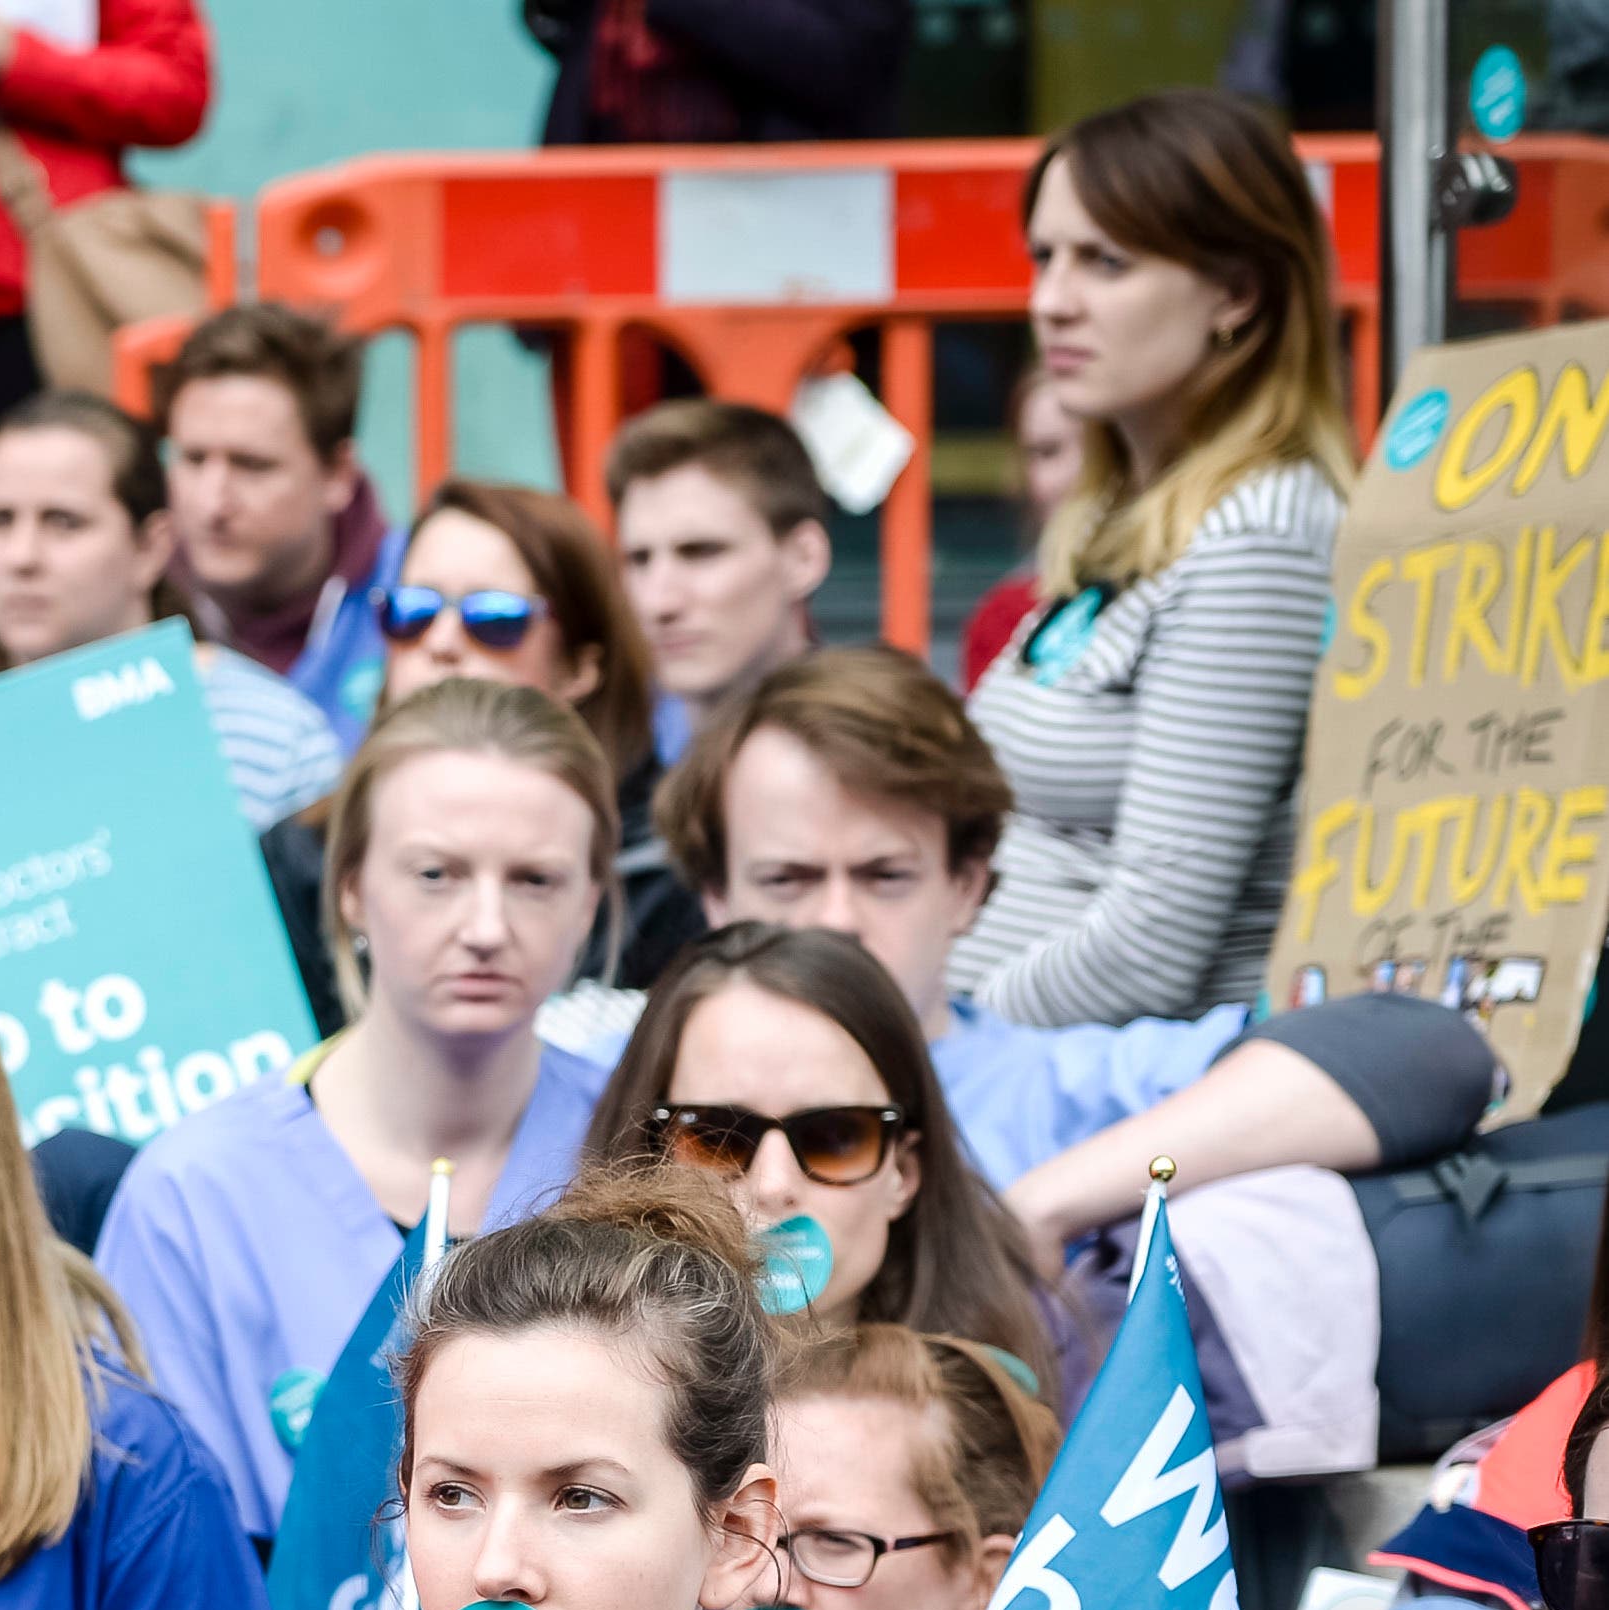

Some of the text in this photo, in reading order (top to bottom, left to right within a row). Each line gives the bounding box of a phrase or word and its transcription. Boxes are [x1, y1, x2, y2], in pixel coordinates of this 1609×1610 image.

[1433, 360, 1609, 512] ON
[72, 657, 175, 722] BMA
[1362, 707, 1568, 797] FOR THE
[1295, 783, 1609, 943] FUTURE
[38, 972, 148, 1055] to
